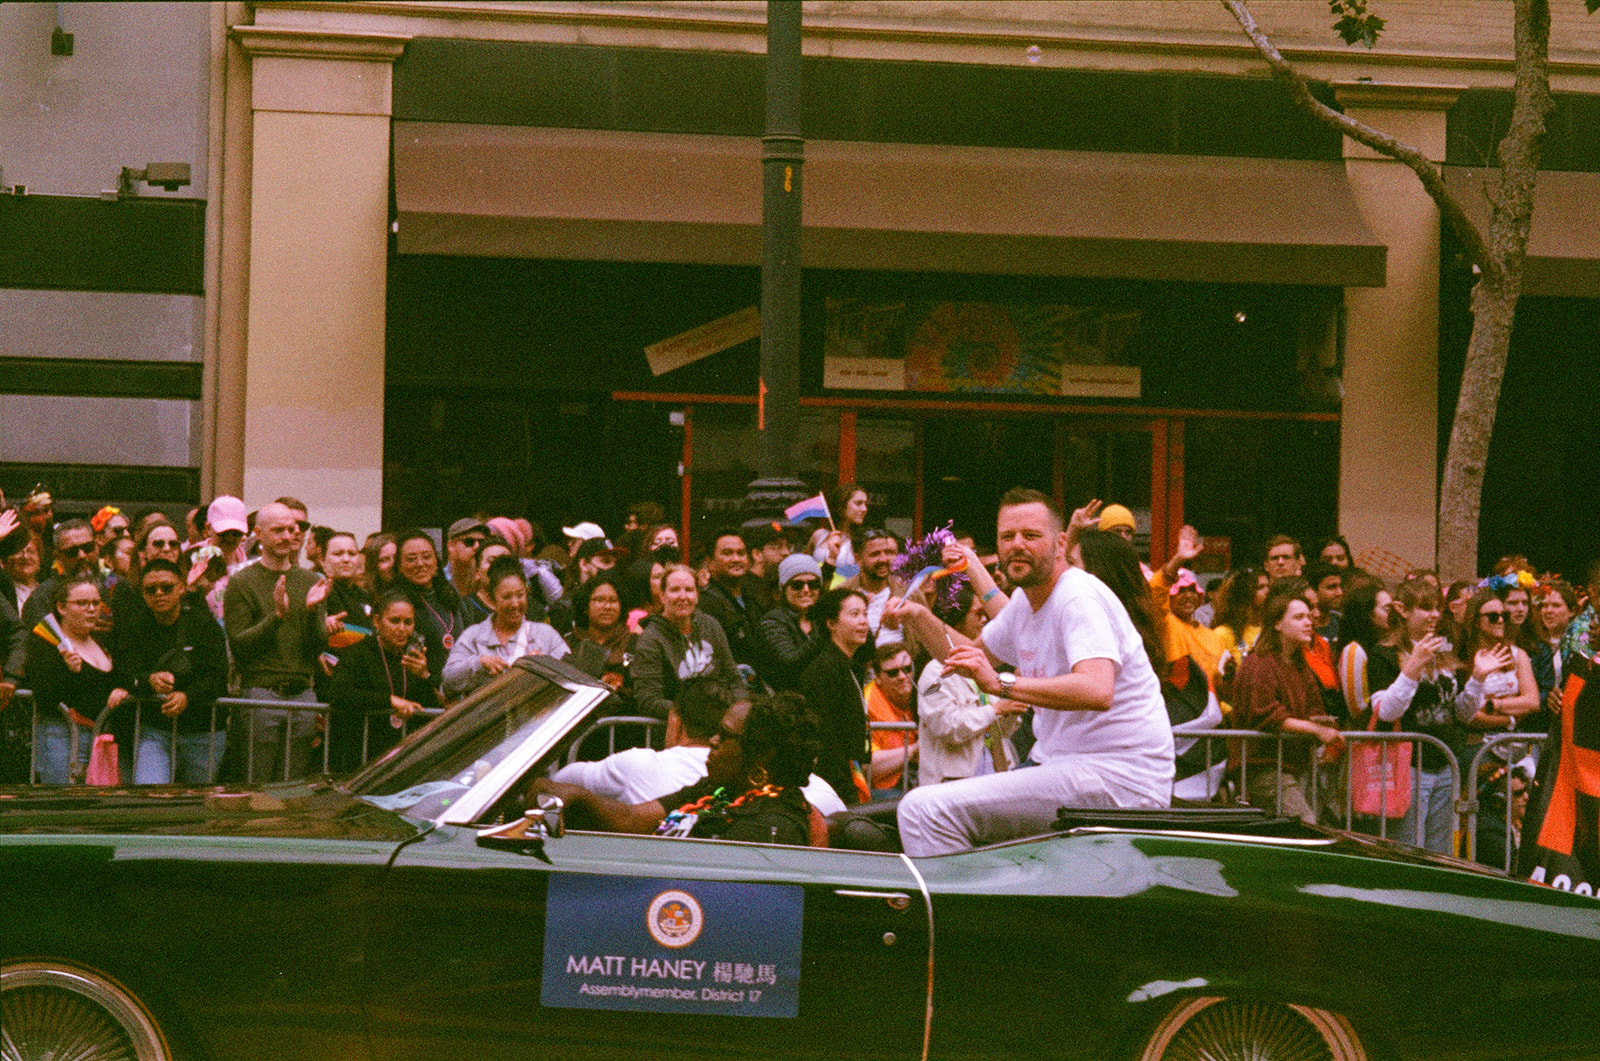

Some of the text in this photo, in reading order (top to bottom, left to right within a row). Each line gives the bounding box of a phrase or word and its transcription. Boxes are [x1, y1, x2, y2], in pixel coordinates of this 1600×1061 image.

[566, 954, 707, 980] MATT HANEY
[701, 987, 744, 1002] District
[749, 989, 762, 1003] 17
